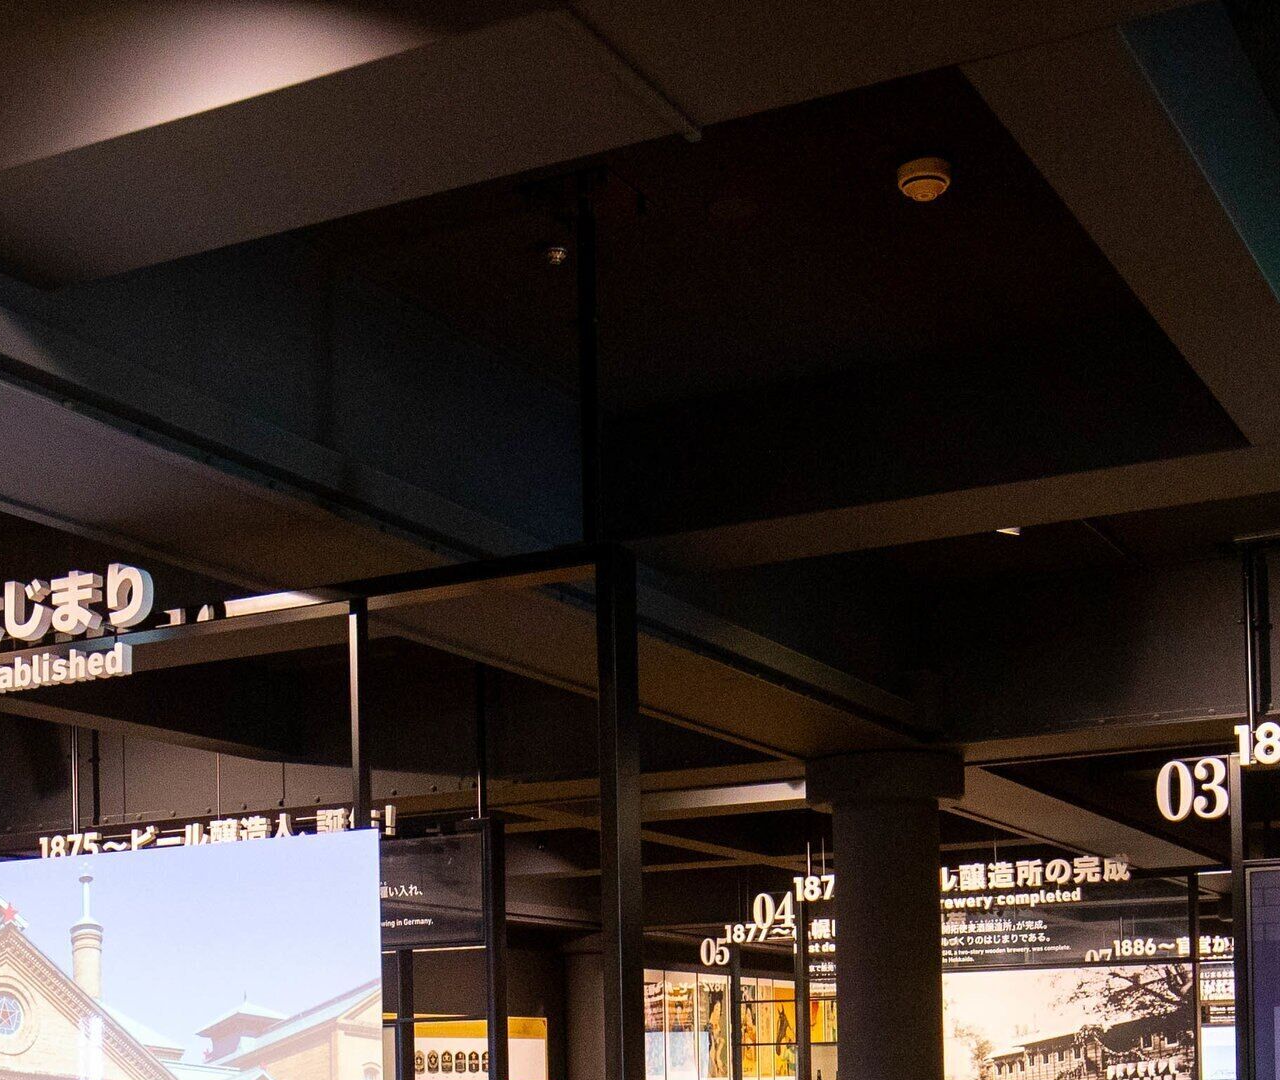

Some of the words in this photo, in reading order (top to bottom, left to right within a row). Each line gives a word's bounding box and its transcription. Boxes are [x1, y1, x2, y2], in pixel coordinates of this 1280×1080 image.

[1156, 757, 1230, 821] 03
[753, 891, 795, 929] 04
[997, 888, 1082, 907] completed
[700, 938, 730, 966] 05
